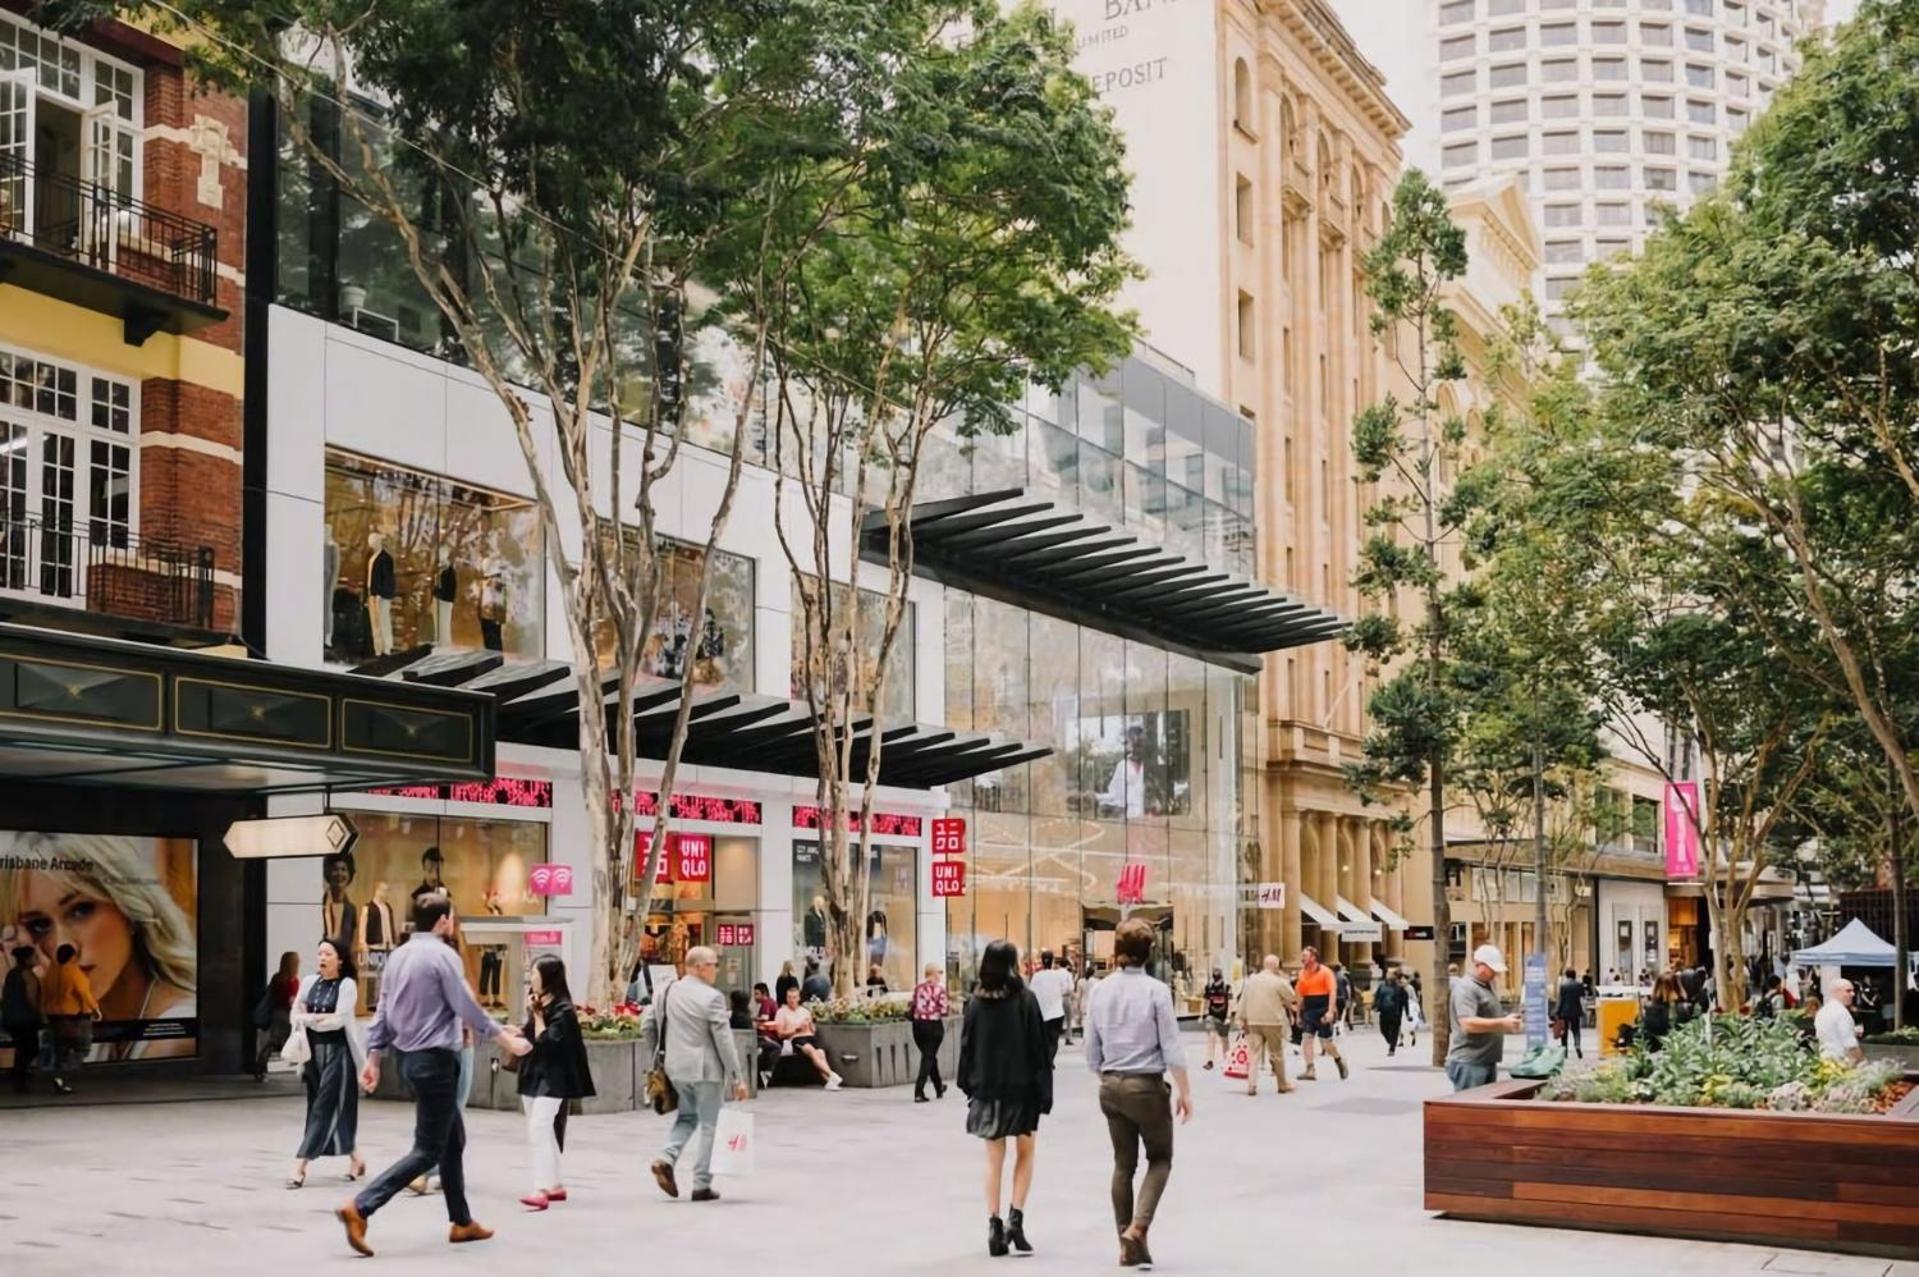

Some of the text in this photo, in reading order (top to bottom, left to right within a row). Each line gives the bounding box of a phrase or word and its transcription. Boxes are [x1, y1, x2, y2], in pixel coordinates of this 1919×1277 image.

[1092, 57, 1168, 94] EPOSIT
[681, 840, 705, 857] UNI
[0, 855, 48, 870] risbane
[681, 859, 707, 879] QLO
[936, 865, 958, 878] UNI
[936, 880, 960, 895] QLO
